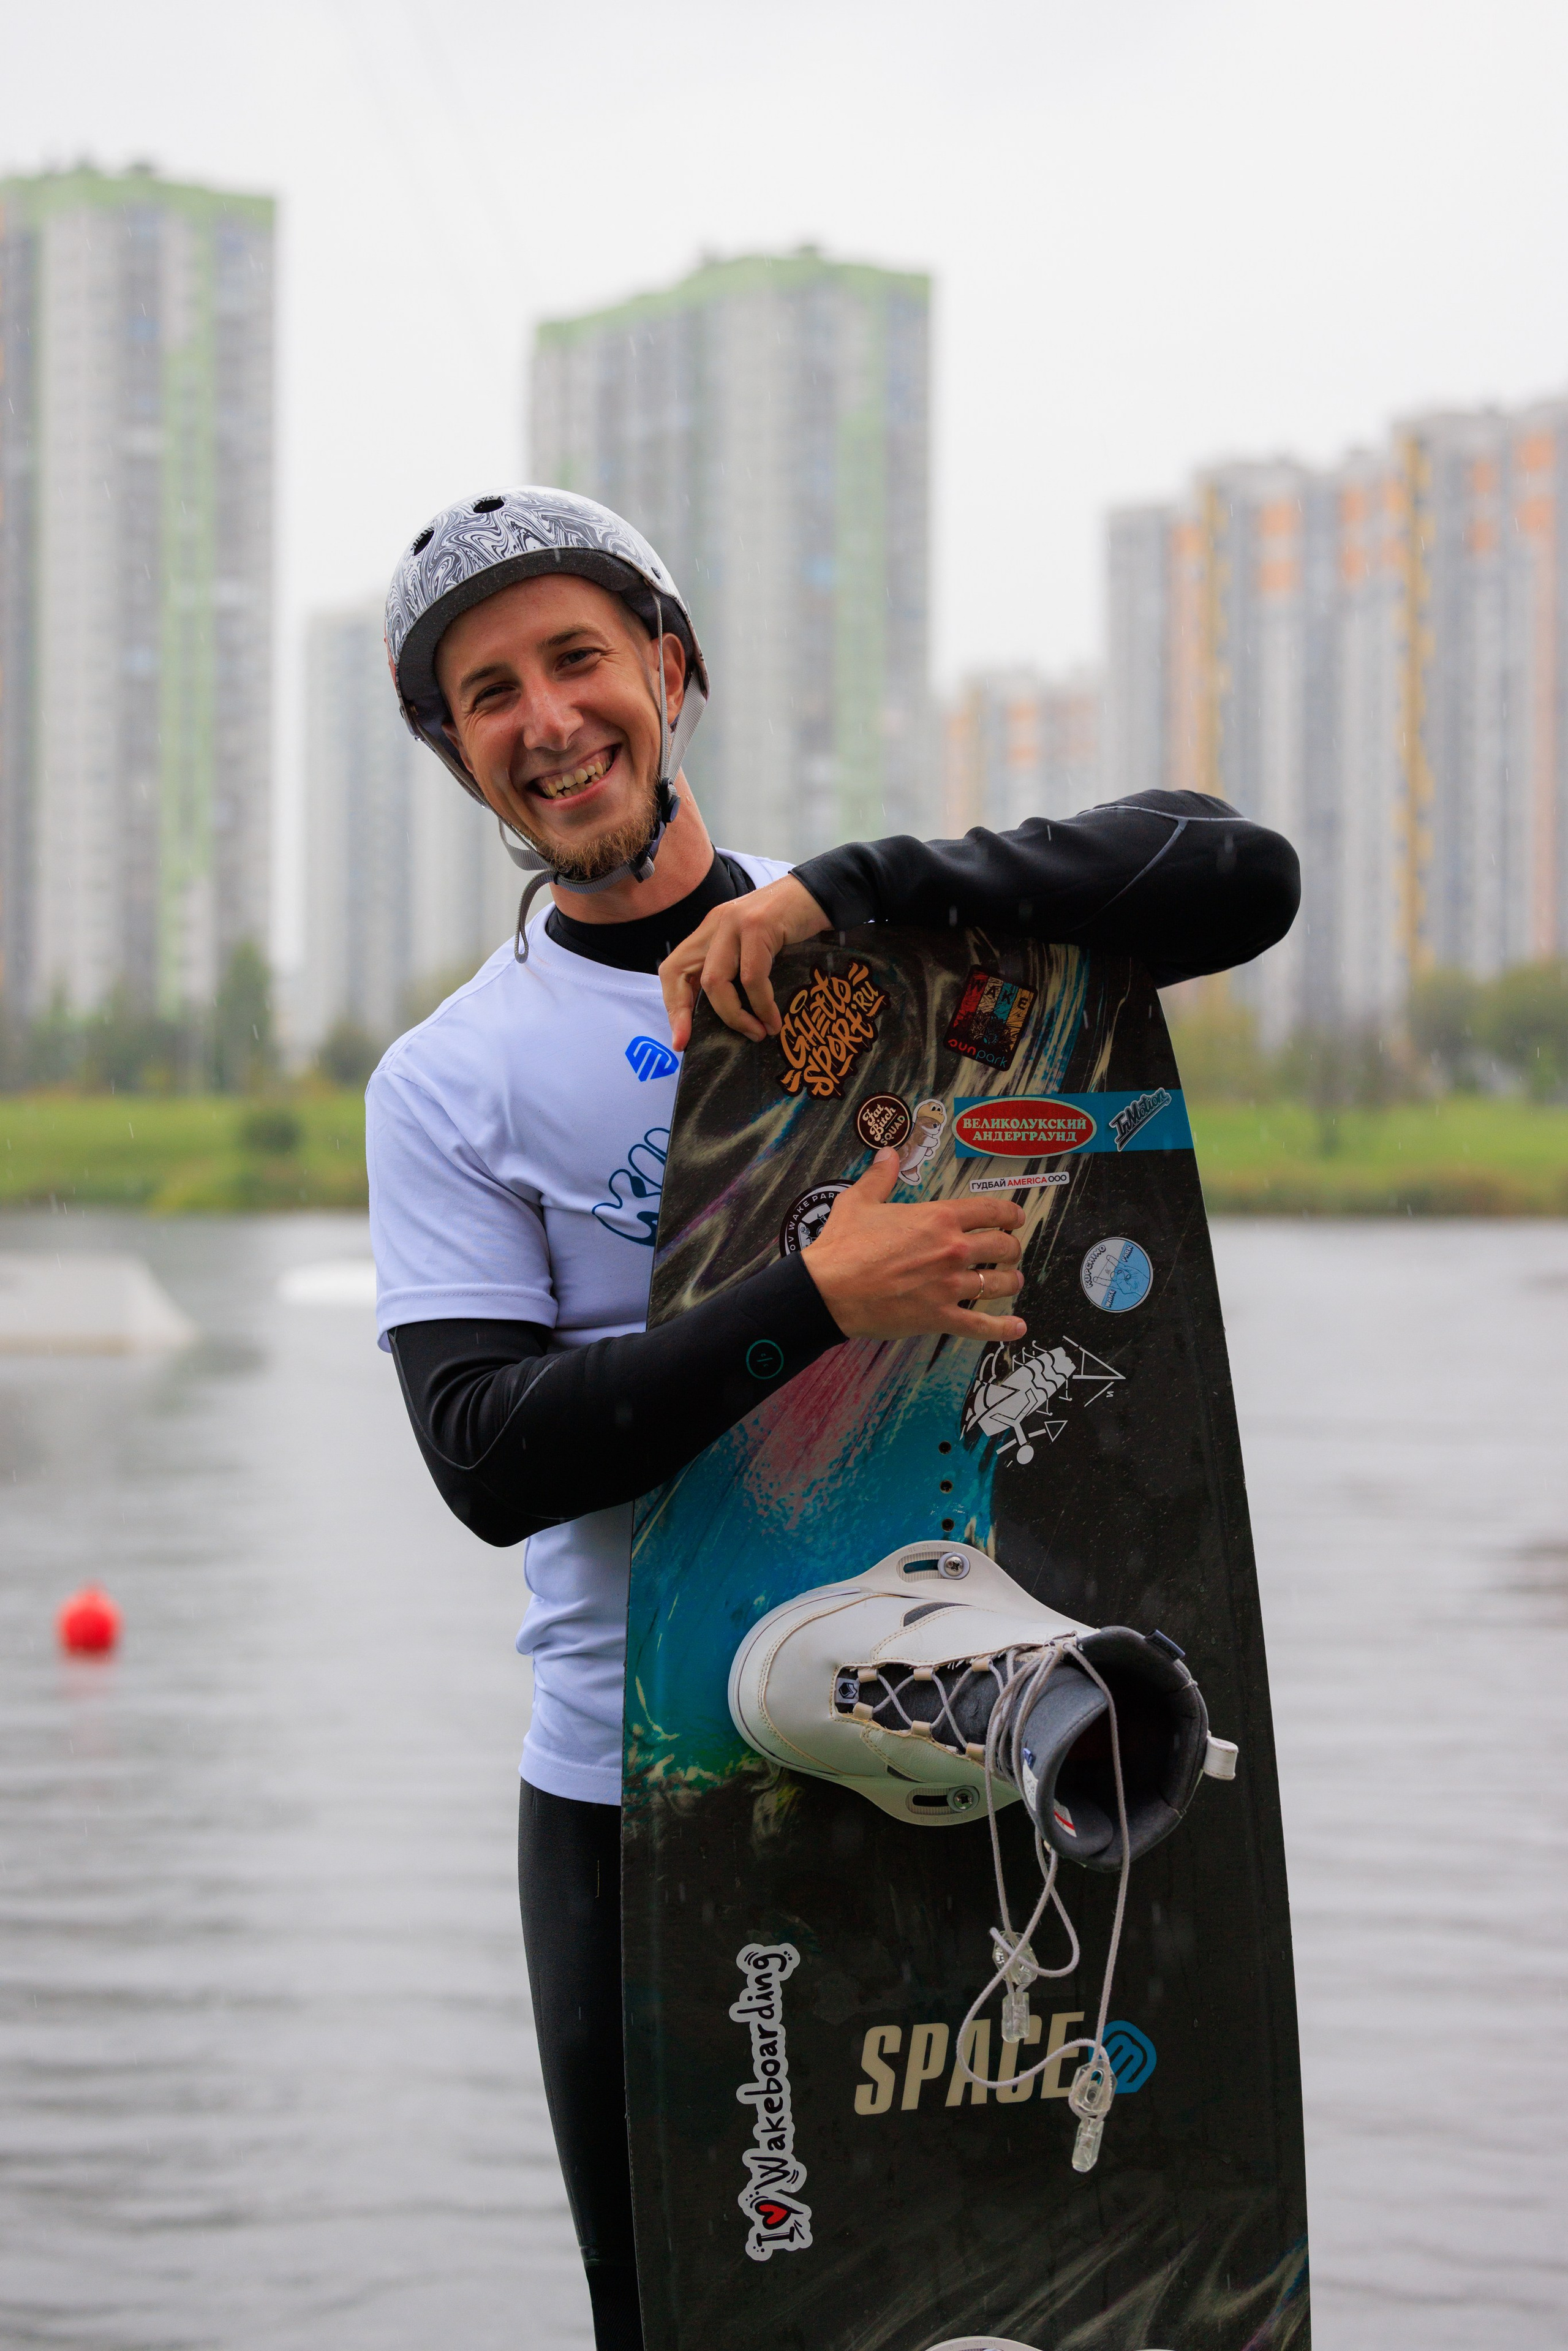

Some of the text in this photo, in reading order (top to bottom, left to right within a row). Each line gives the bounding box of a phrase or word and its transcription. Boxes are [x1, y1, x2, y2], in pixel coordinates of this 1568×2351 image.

[971, 980, 1028, 1010] WAKE
[862, 1103, 884, 1126] Fat
[870, 1107, 896, 1141] Bitch
[963, 1117, 1087, 1130] ВЕЛИКОЛУКСКИЙ
[880, 1115, 905, 1145] SQUAD
[973, 1131, 1077, 1142] АНДЕРГРАУНД
[971, 1179, 1006, 1190] ГУДБАЙ
[1008, 1176, 1047, 1187] AMERICA
[788, 1201, 810, 1231] WAKE
[812, 1192, 839, 1202] PAR
[1121, 1245, 1134, 1262] PARK
[1105, 1289, 1117, 1308] WAKE
[737, 1952, 788, 2190] Wakeboarding
[854, 2011, 1085, 2116] SPACE
